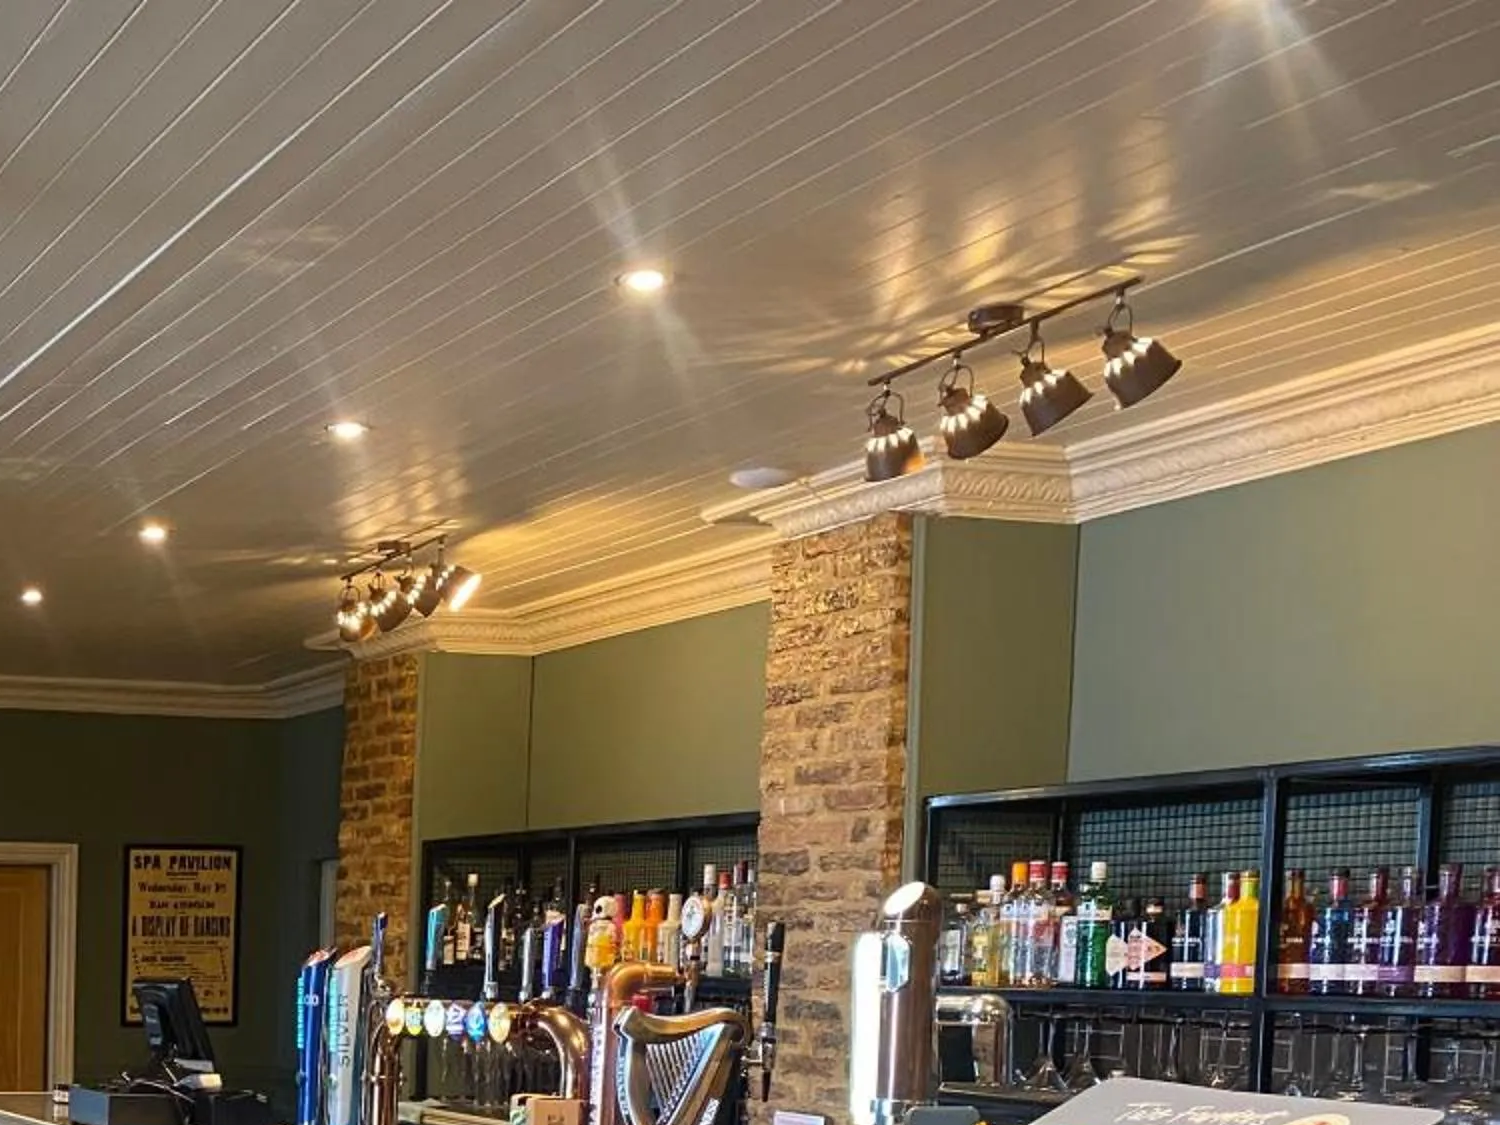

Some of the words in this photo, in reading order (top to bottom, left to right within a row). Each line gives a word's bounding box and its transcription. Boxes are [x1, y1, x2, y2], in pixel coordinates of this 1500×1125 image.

[134, 855, 161, 870] SPA
[169, 856, 231, 871] PAVILION
[338, 993, 350, 1068] SILVER
